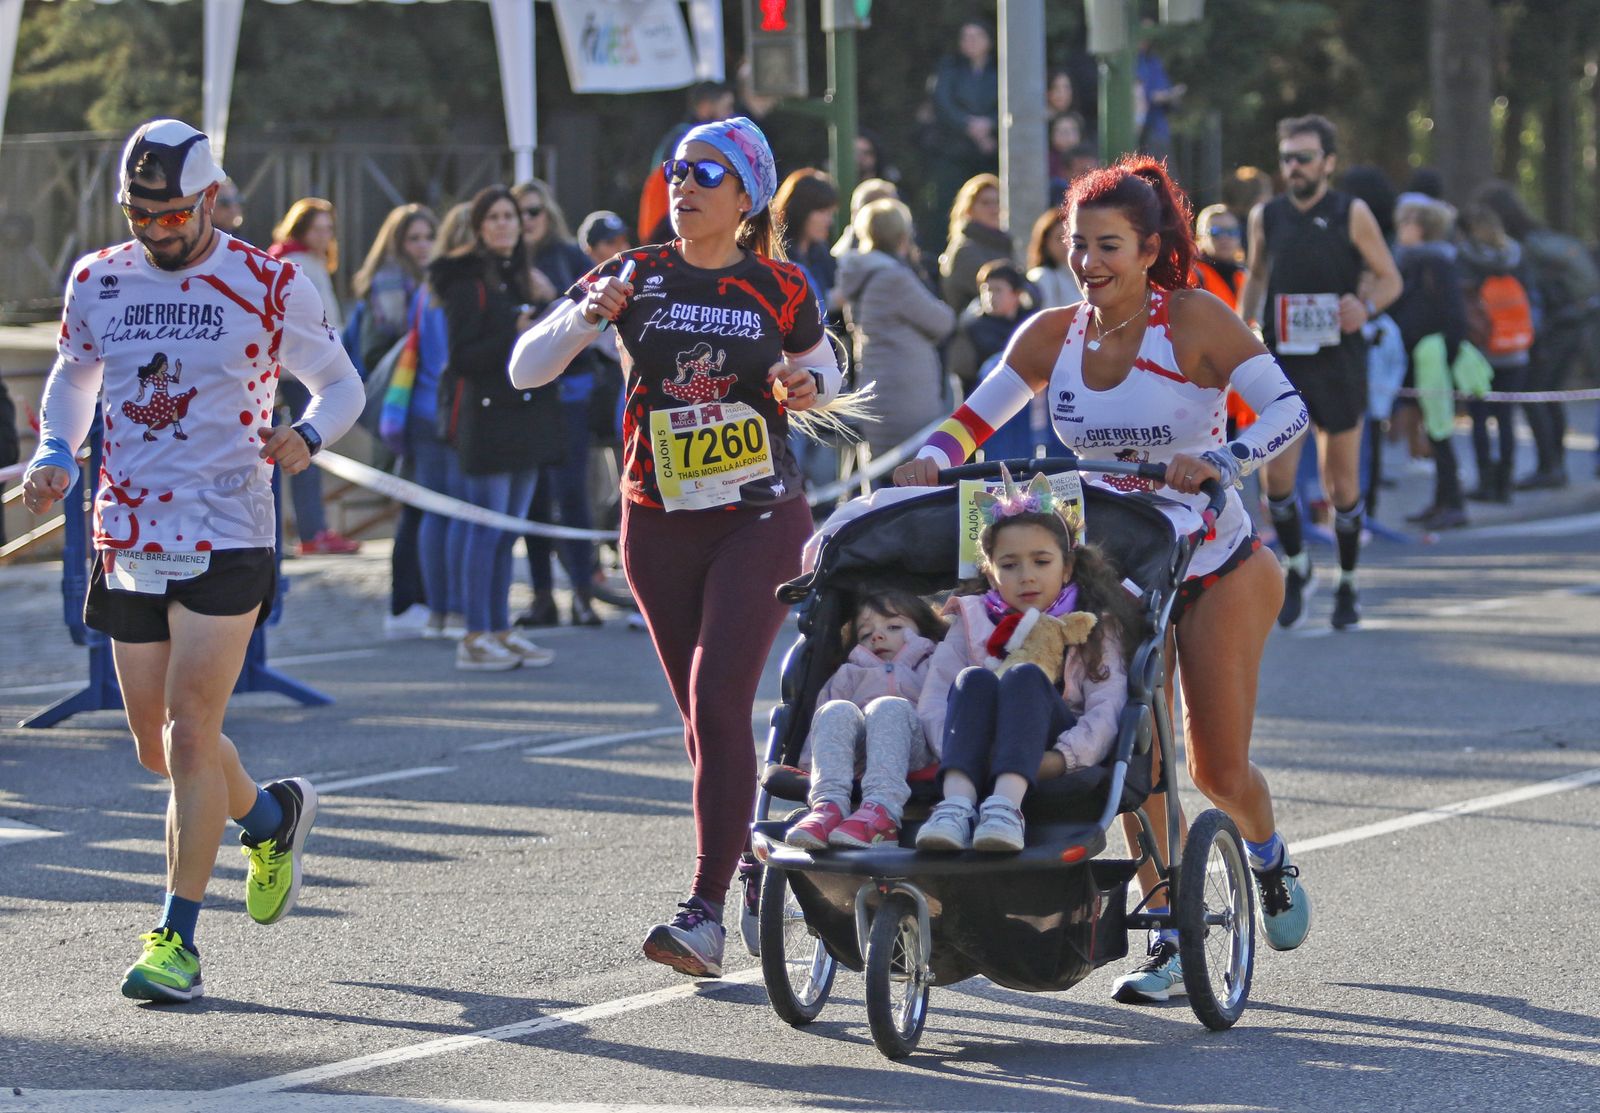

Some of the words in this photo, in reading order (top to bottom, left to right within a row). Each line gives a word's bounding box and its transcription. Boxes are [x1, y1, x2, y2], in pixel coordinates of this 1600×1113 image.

[124, 303, 224, 327] GUERRERAS
[639, 308, 765, 342] flamencas
[670, 303, 761, 329] GUERRERAS
[101, 317, 229, 354] flamencas
[675, 418, 763, 468] 7260
[1073, 436, 1178, 455] flamencas
[1086, 425, 1172, 441] GUERRERAS
[678, 471, 700, 480] THAIS
[701, 464, 734, 476] MORILLA
[735, 454, 767, 468] ALFONSO
[146, 552, 171, 562] BAREA
[173, 555, 206, 564] JIMENEZ
